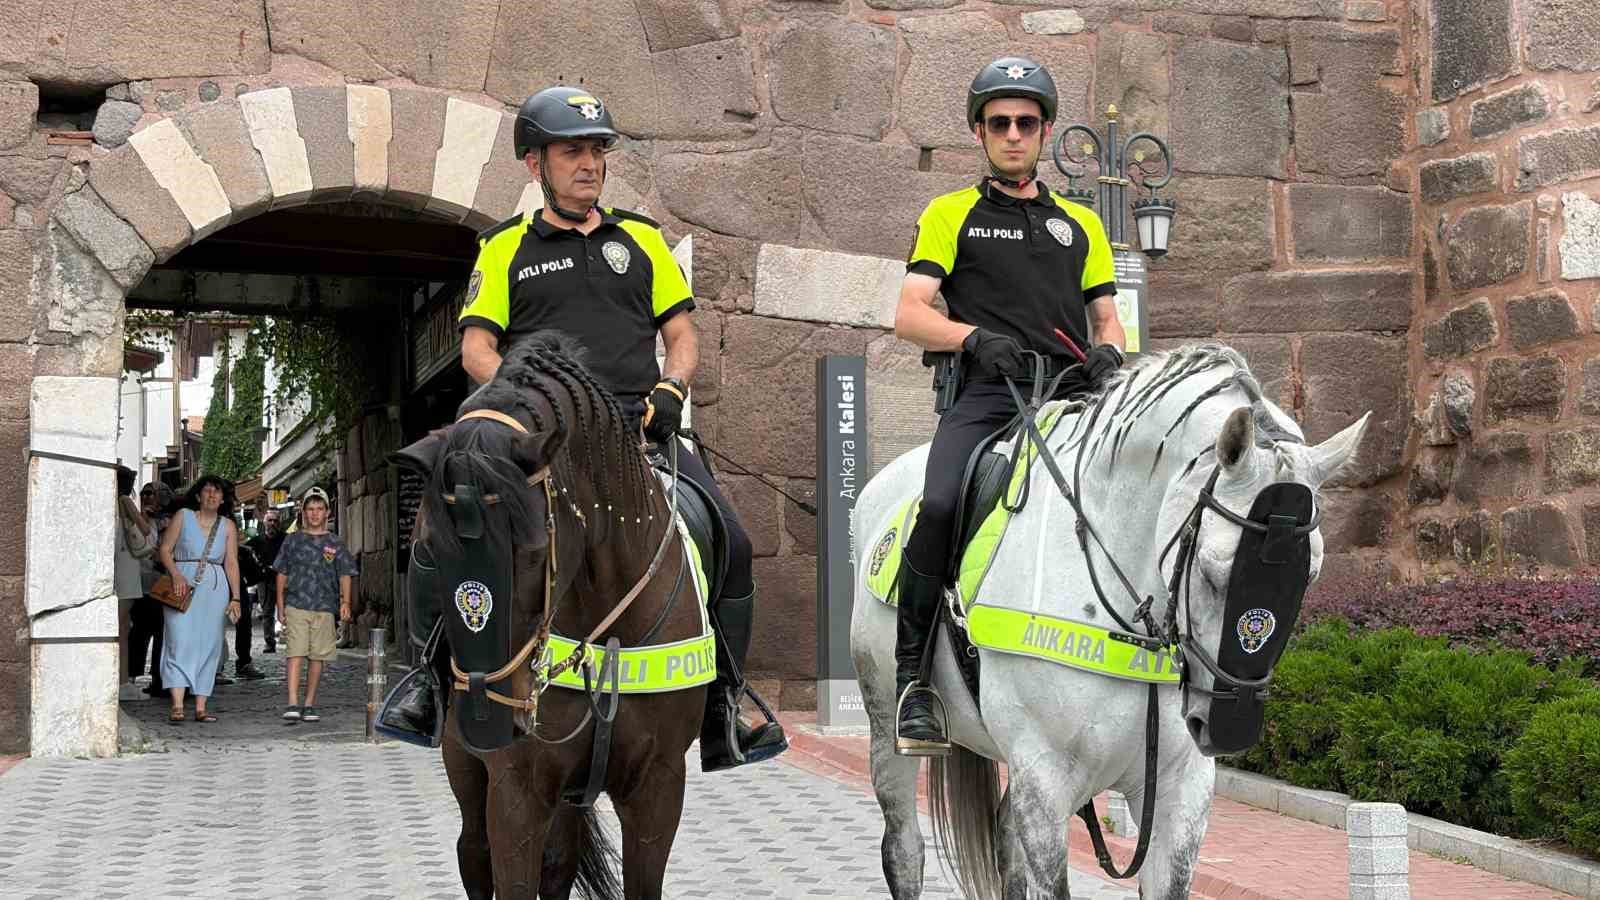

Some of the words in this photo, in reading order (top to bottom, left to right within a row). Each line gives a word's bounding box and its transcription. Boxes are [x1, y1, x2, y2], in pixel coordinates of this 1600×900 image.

[967, 227, 991, 238] ATLI
[518, 264, 540, 281] ATLI
[837, 375, 855, 434] Kalesi
[839, 440, 856, 500] Ankara
[665, 642, 714, 681] POLİS
[1022, 621, 1105, 665] ANKARA
